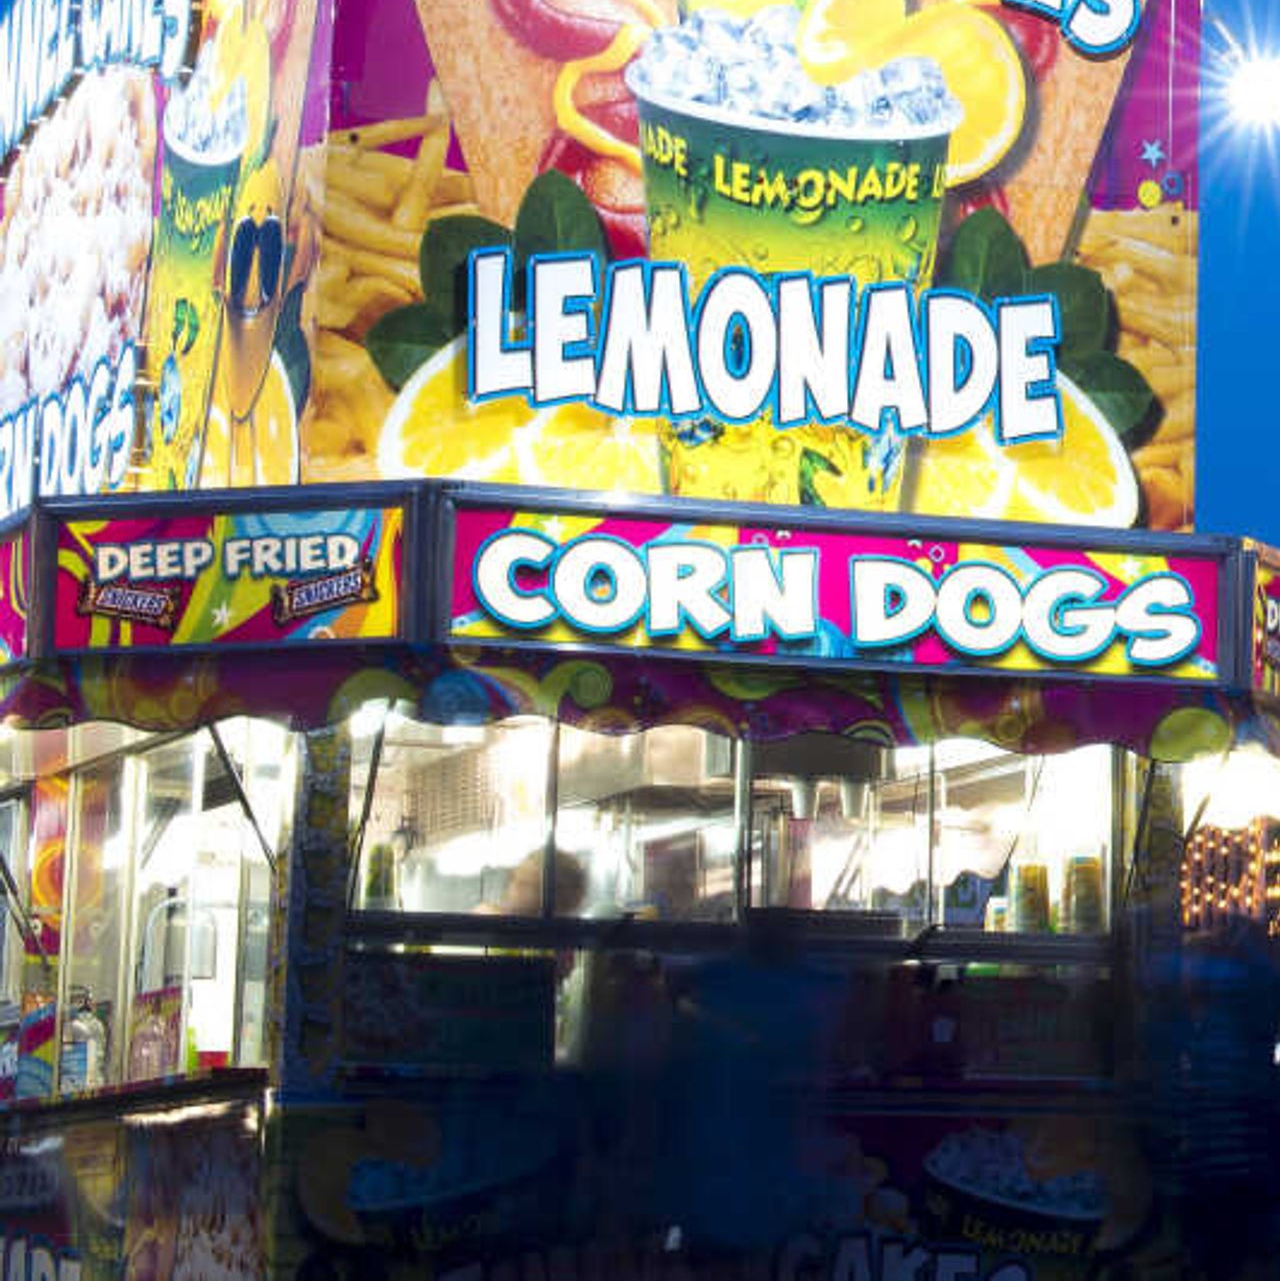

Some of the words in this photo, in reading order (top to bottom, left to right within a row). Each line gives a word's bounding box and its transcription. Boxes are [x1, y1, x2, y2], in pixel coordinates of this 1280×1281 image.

[712, 154, 921, 210] LEMONADE
[467, 246, 1063, 445] LEMONADE
[40, 338, 136, 496] DOGS
[96, 542, 214, 582] DEEP
[224, 534, 361, 579] FRIED
[472, 528, 819, 642] CORN
[850, 555, 1200, 666] DOGS
